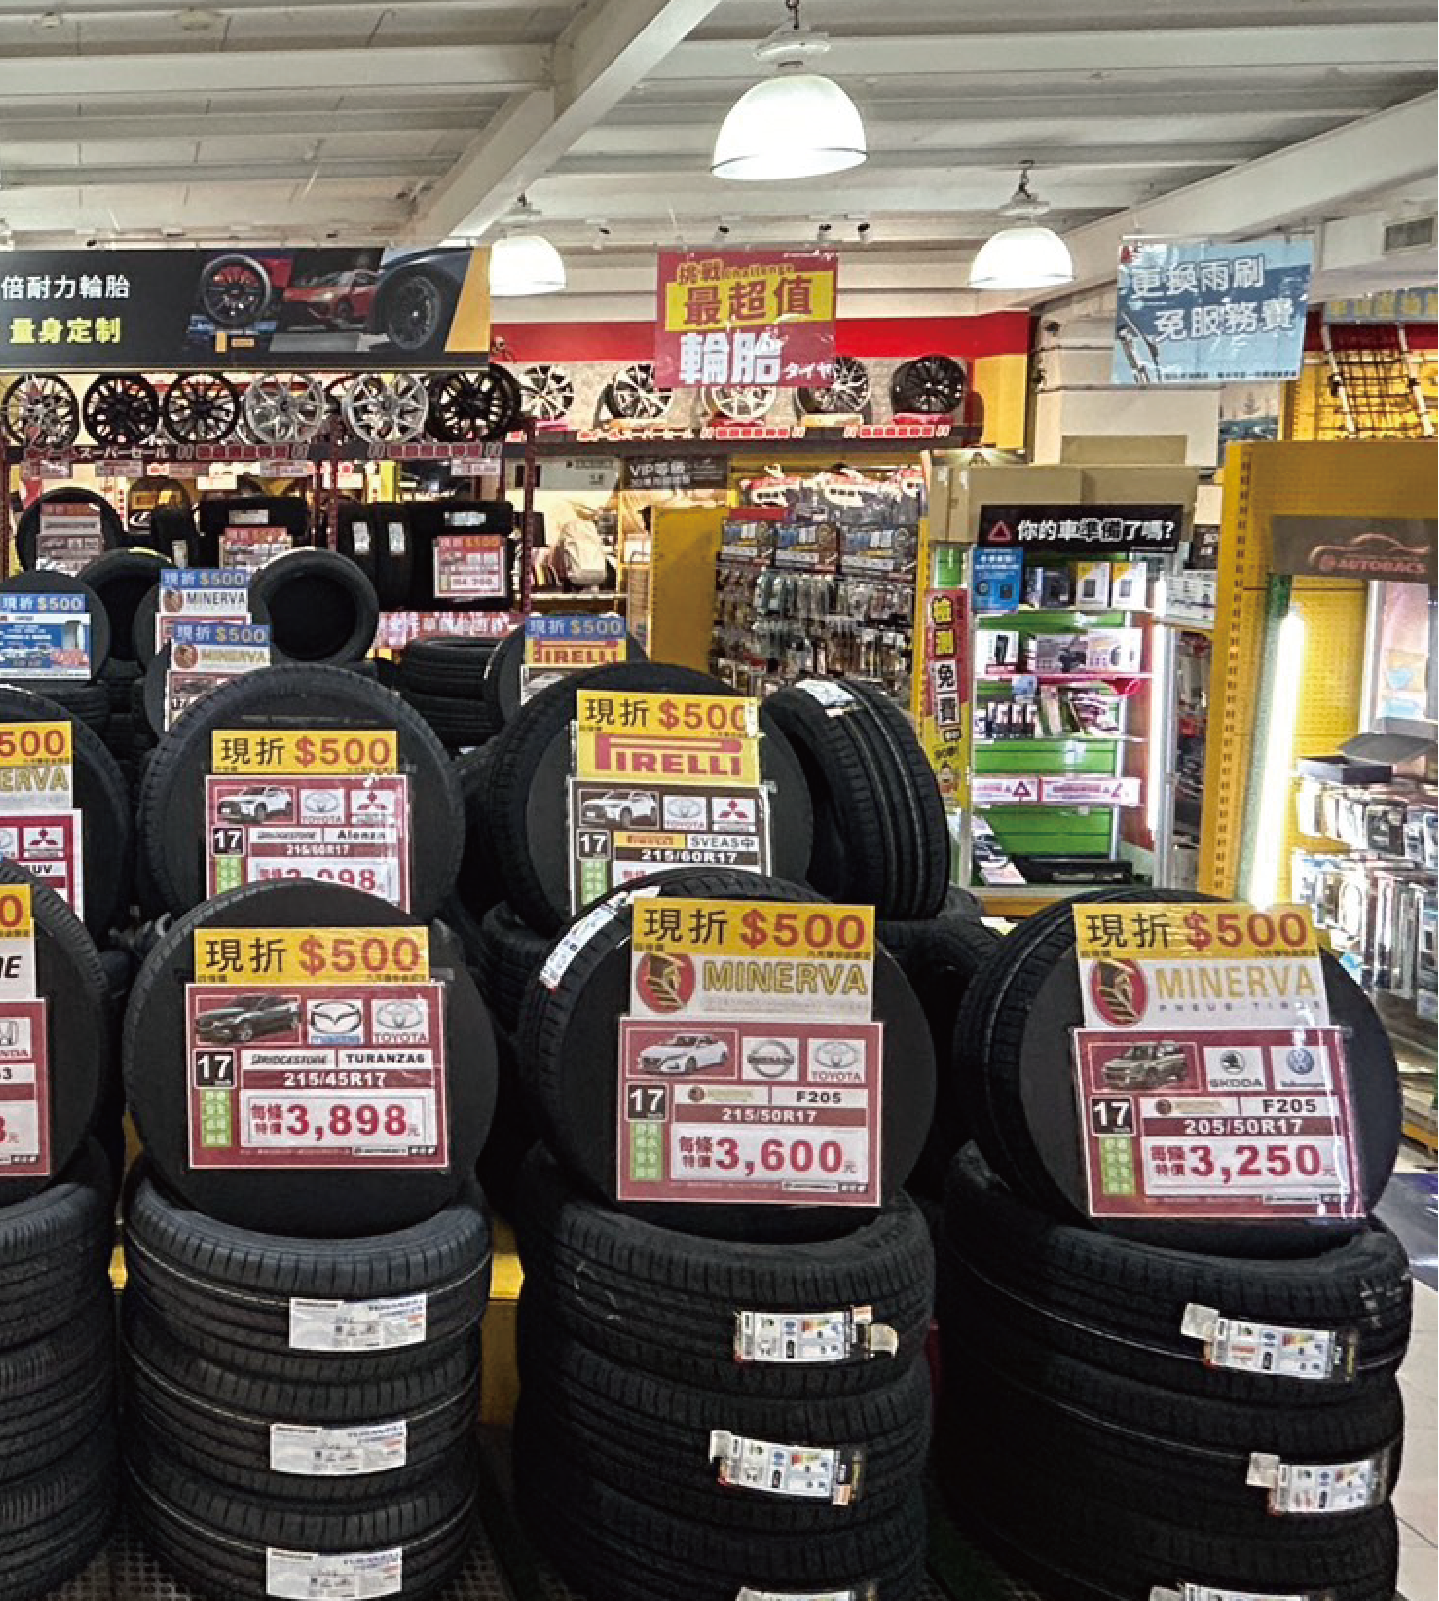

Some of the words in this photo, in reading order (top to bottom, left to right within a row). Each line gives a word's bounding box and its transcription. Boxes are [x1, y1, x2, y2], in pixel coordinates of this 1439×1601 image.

[1, 275, 130, 298] 倍耐力輪胎
[1131, 254, 1265, 299] 更換雨刷
[684, 275, 814, 326] 最超值
[9, 318, 121, 344] 量身定制
[1154, 297, 1294, 342] 免服務費
[680, 330, 784, 384] 輪胎
[1018, 518, 1175, 542] 你的車準備了嗎?
[163, 570, 196, 586] 現折
[200, 571, 246, 586] $500
[1, 596, 33, 611] 現折
[37, 597, 83, 611] $500
[186, 591, 245, 605] MINERVA
[175, 626, 211, 642] 現折
[216, 628, 268, 643] $500
[530, 618, 564, 635] 現折
[572, 619, 622, 635] $500
[533, 640, 618, 664] PIRELLI
[585, 698, 649, 727] 現折
[220, 737, 285, 765] 現折
[294, 736, 391, 768] $500
[594, 732, 743, 776] PIRELLI
[215, 831, 242, 848] 17
[580, 834, 606, 852] 17
[643, 907, 728, 945] 現折
[740, 909, 865, 950] $500
[1085, 913, 1169, 948] 現折
[1183, 910, 1309, 952] $500
[205, 937, 287, 973] 現折
[298, 935, 421, 977] $500
[702, 960, 868, 996] MINERVA
[1155, 966, 1318, 999] MINERVA
[373, 1033, 427, 1042] TOYOTA
[197, 1055, 232, 1079] 17
[346, 1054, 425, 1064] TURANZA6
[284, 1072, 386, 1087] 215/45R17
[629, 1089, 664, 1112] 17
[796, 1091, 841, 1103] F205
[1263, 1099, 1317, 1113] F205
[721, 1108, 817, 1122] 215/50R17
[1093, 1101, 1130, 1126] 17
[1184, 1119, 1303, 1135] 205/50R17
